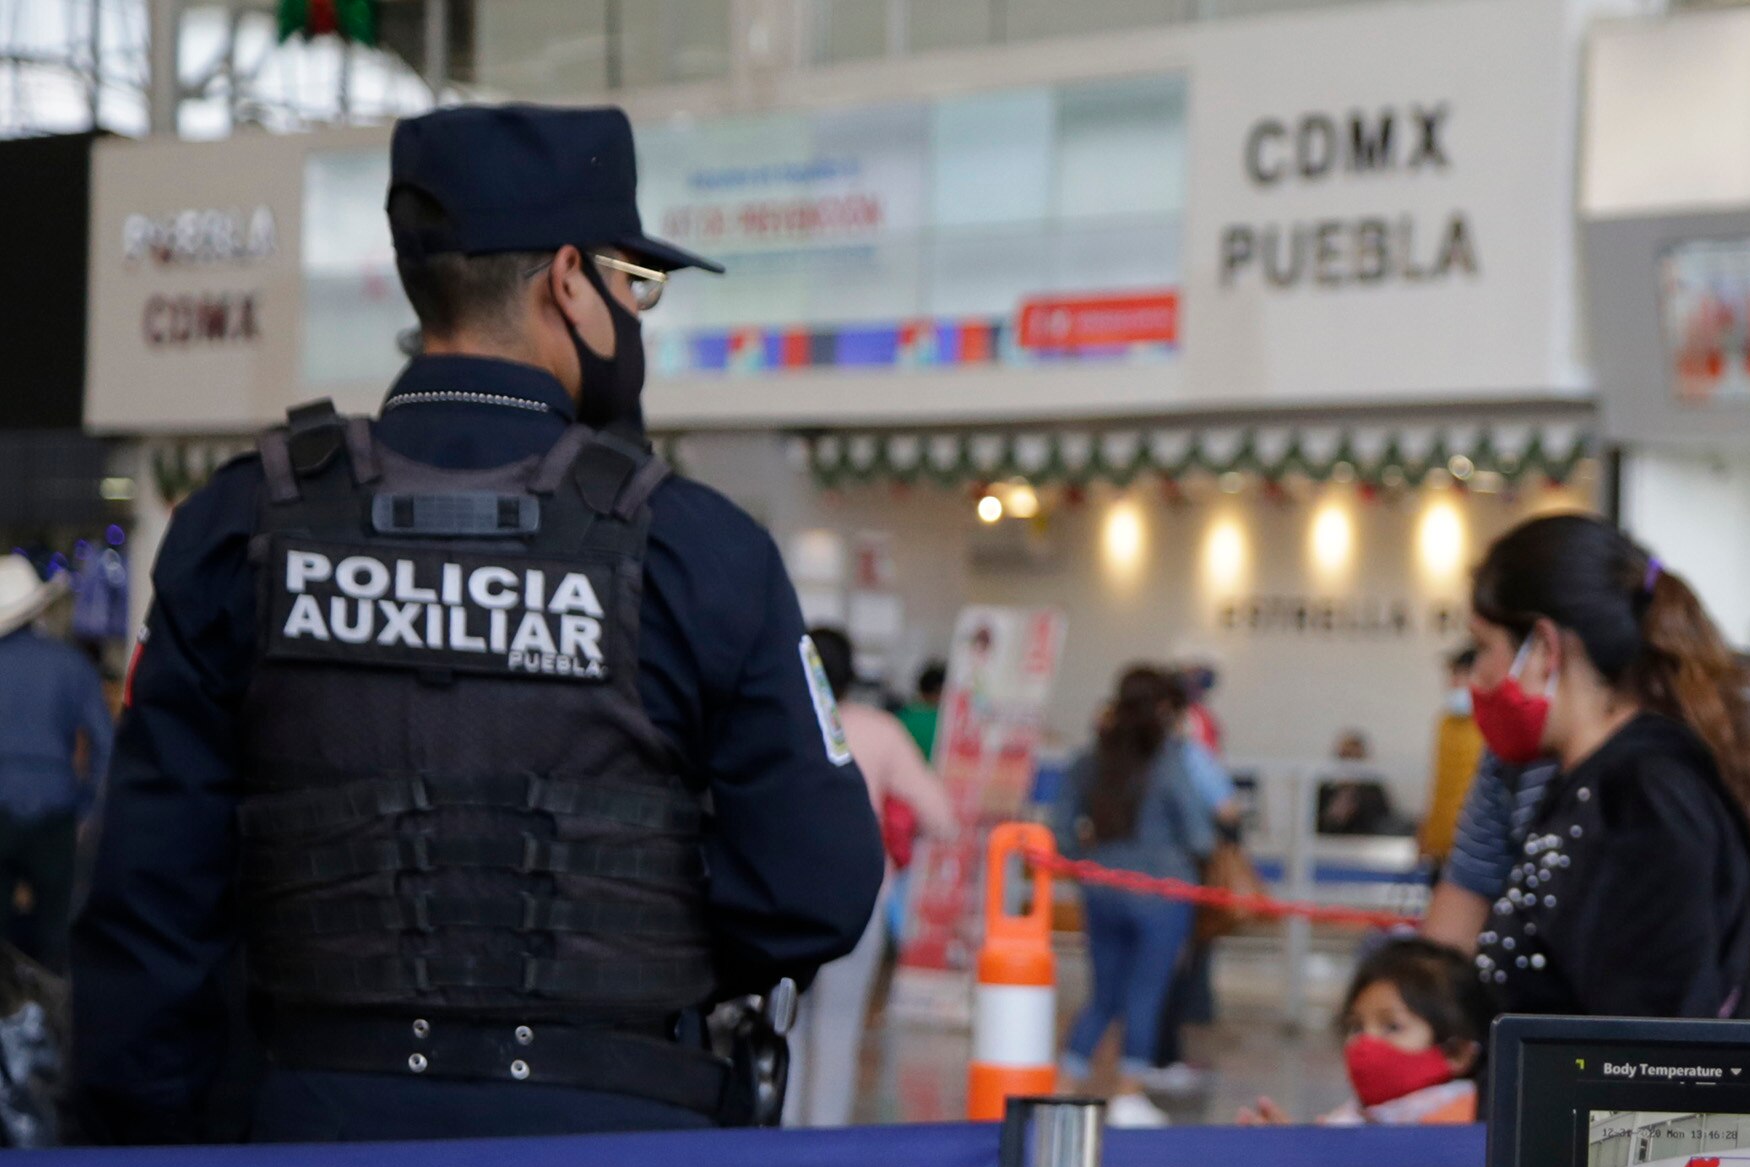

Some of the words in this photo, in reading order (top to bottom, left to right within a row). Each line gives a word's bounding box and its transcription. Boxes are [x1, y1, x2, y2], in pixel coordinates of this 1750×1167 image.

[1244, 102, 1453, 187] CDMX
[124, 207, 276, 262] PUEBLA
[1217, 210, 1480, 290] PUEBLA
[142, 294, 259, 347] CDMX
[286, 549, 604, 618] POLICIA
[283, 594, 603, 663] AUXILIAR
[508, 650, 602, 677] PUEBLA
[1604, 1062, 1637, 1078] Body
[1640, 1063, 1723, 1078] Temperature
[1667, 1129, 1685, 1139] Mon
